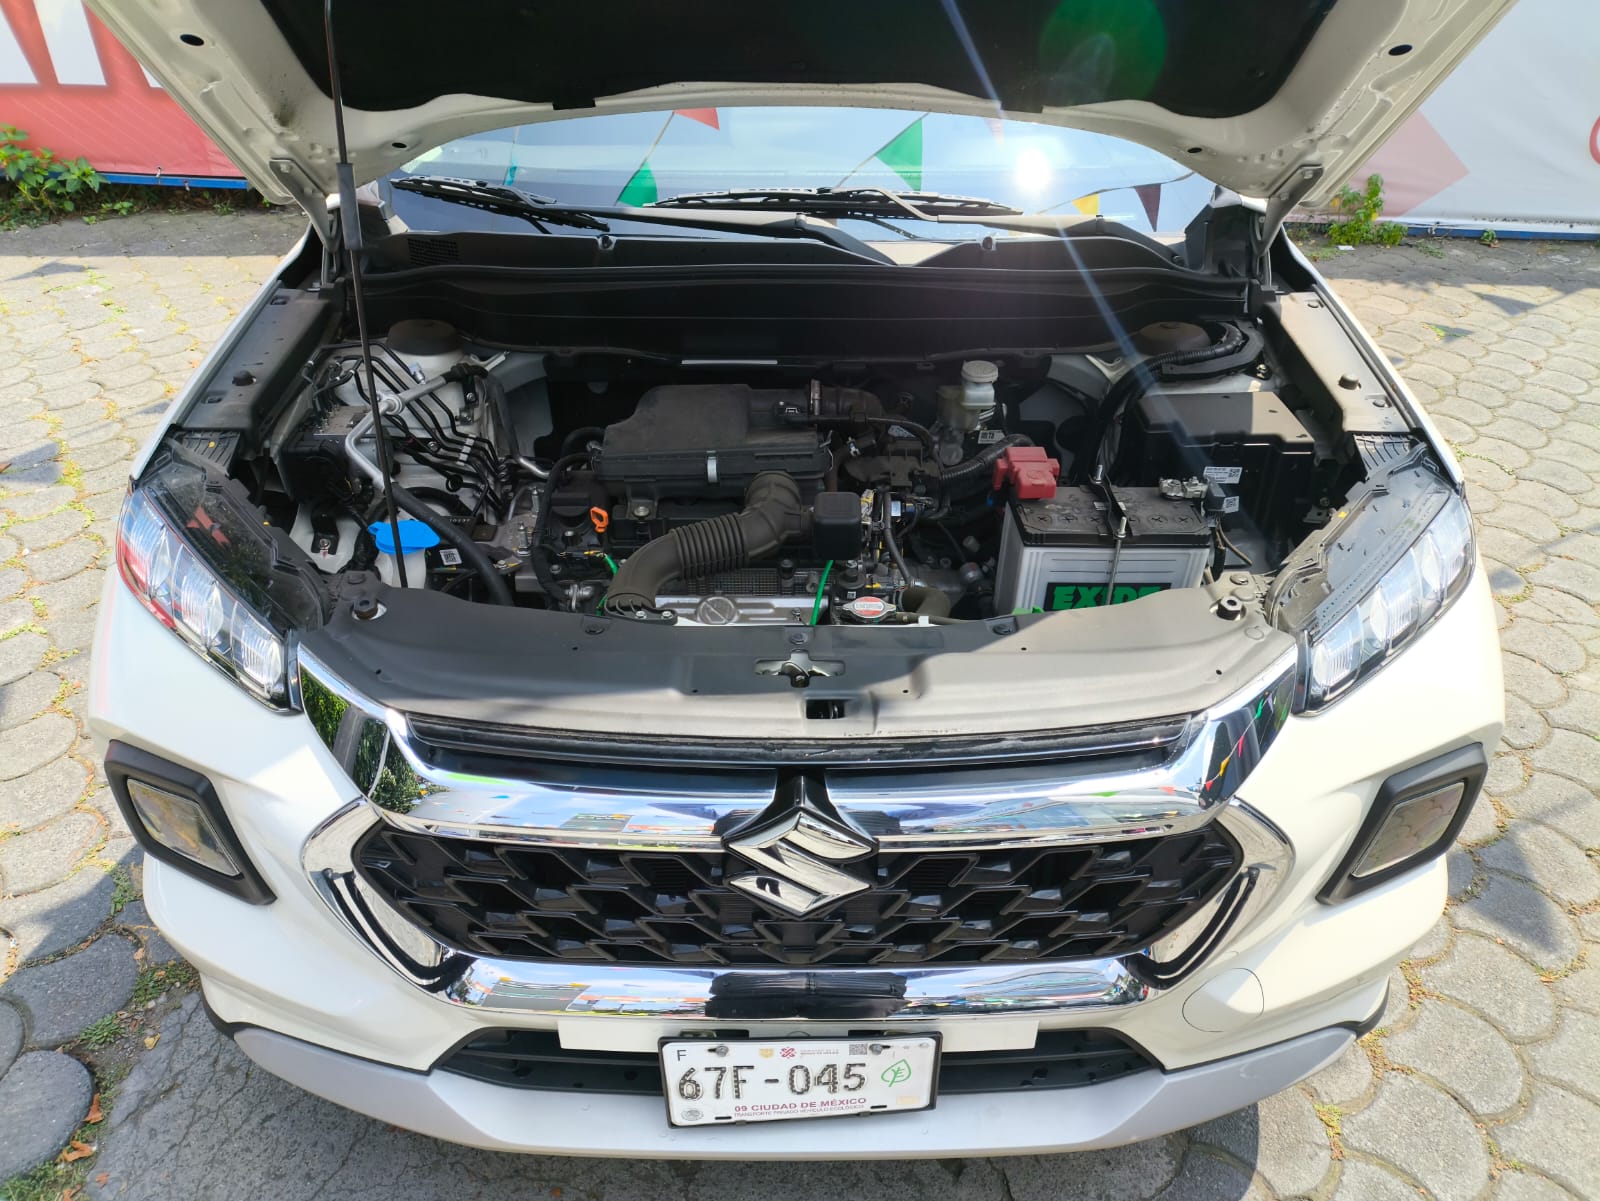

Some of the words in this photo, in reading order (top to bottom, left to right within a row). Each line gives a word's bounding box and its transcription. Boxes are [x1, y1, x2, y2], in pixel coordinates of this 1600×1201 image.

[677, 1049, 687, 1061] F
[679, 1063, 867, 1100] 67F-045
[751, 1103, 798, 1111] CIUDAD
[820, 1097, 867, 1107] MÉXICO
